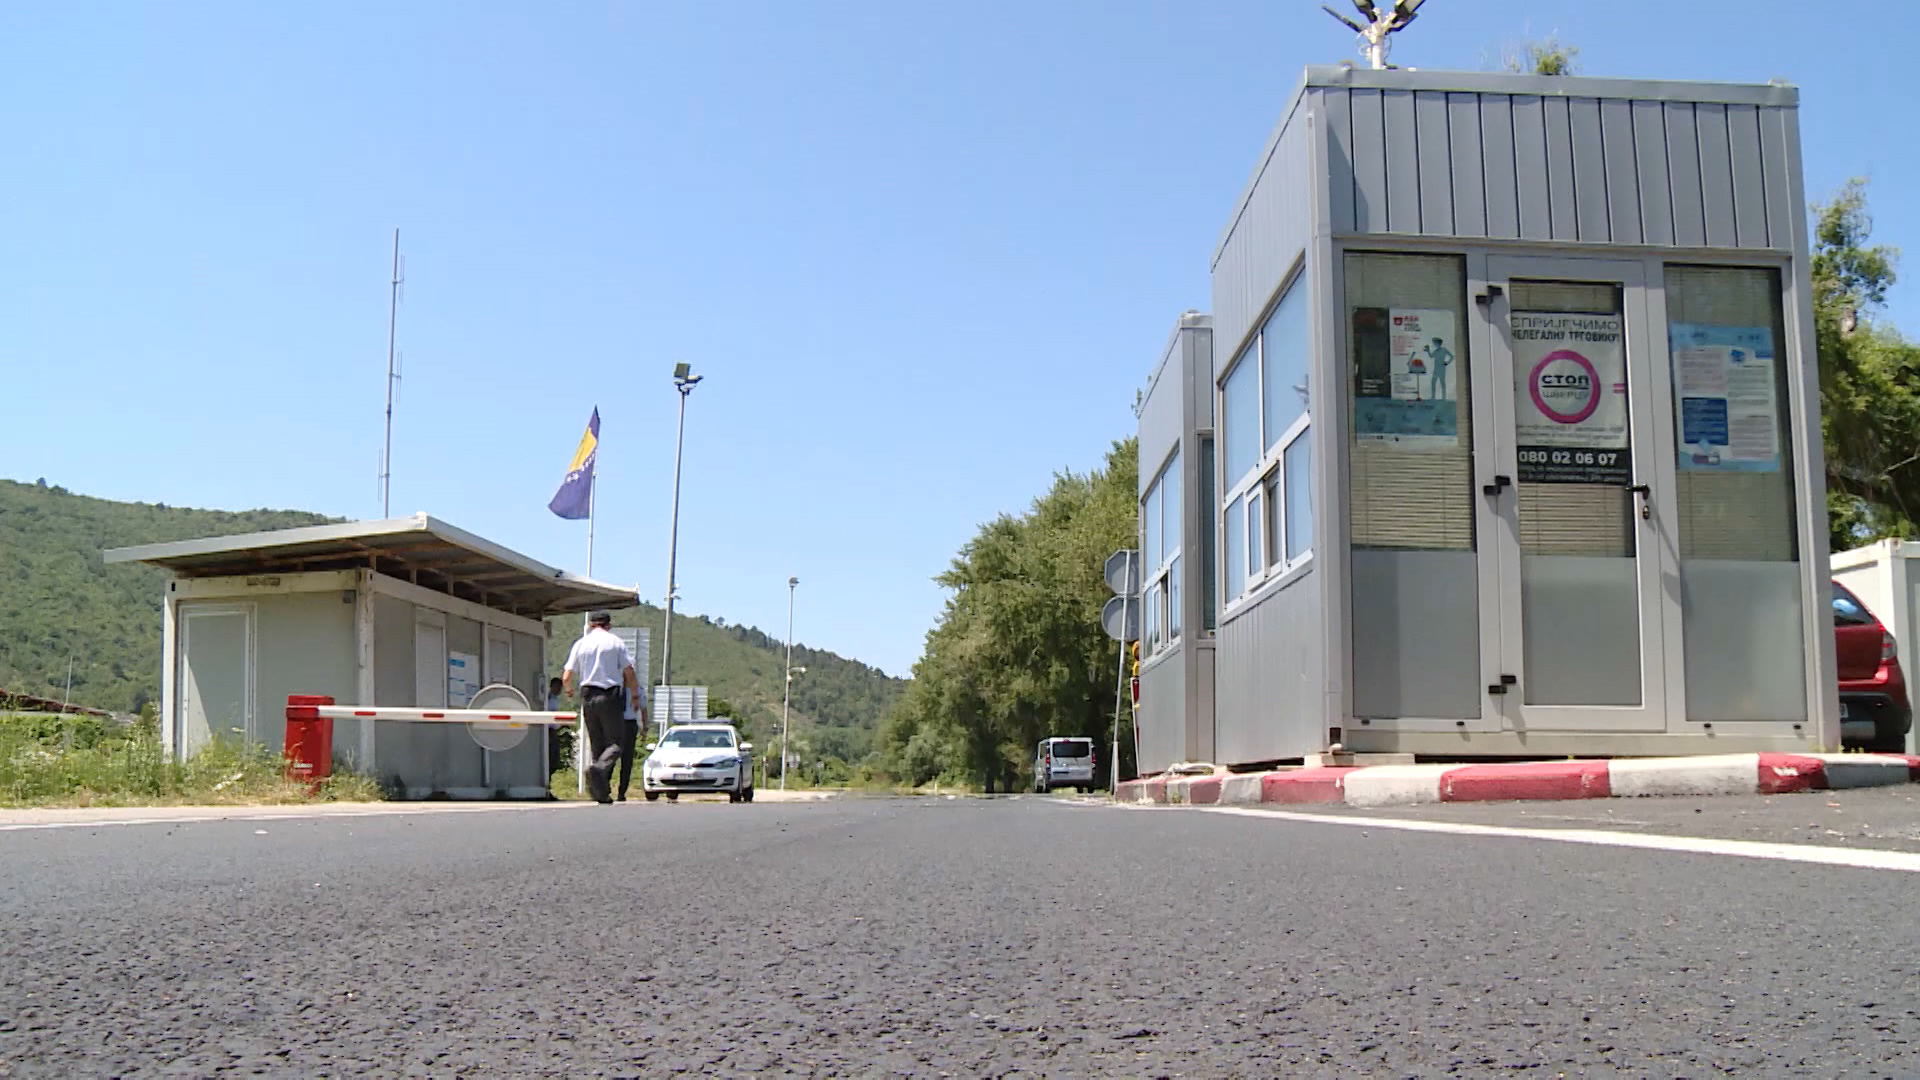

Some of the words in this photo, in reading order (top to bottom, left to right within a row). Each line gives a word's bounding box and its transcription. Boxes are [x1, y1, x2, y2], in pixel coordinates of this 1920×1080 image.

[1511, 316, 1619, 330] СПРИЈЕЧИМО
[1541, 374, 1590, 386] СТОП
[1518, 450, 1548, 464] 080
[1551, 451, 1571, 465] 02
[1575, 452, 1595, 465] 06
[1598, 453, 1617, 467] 07
